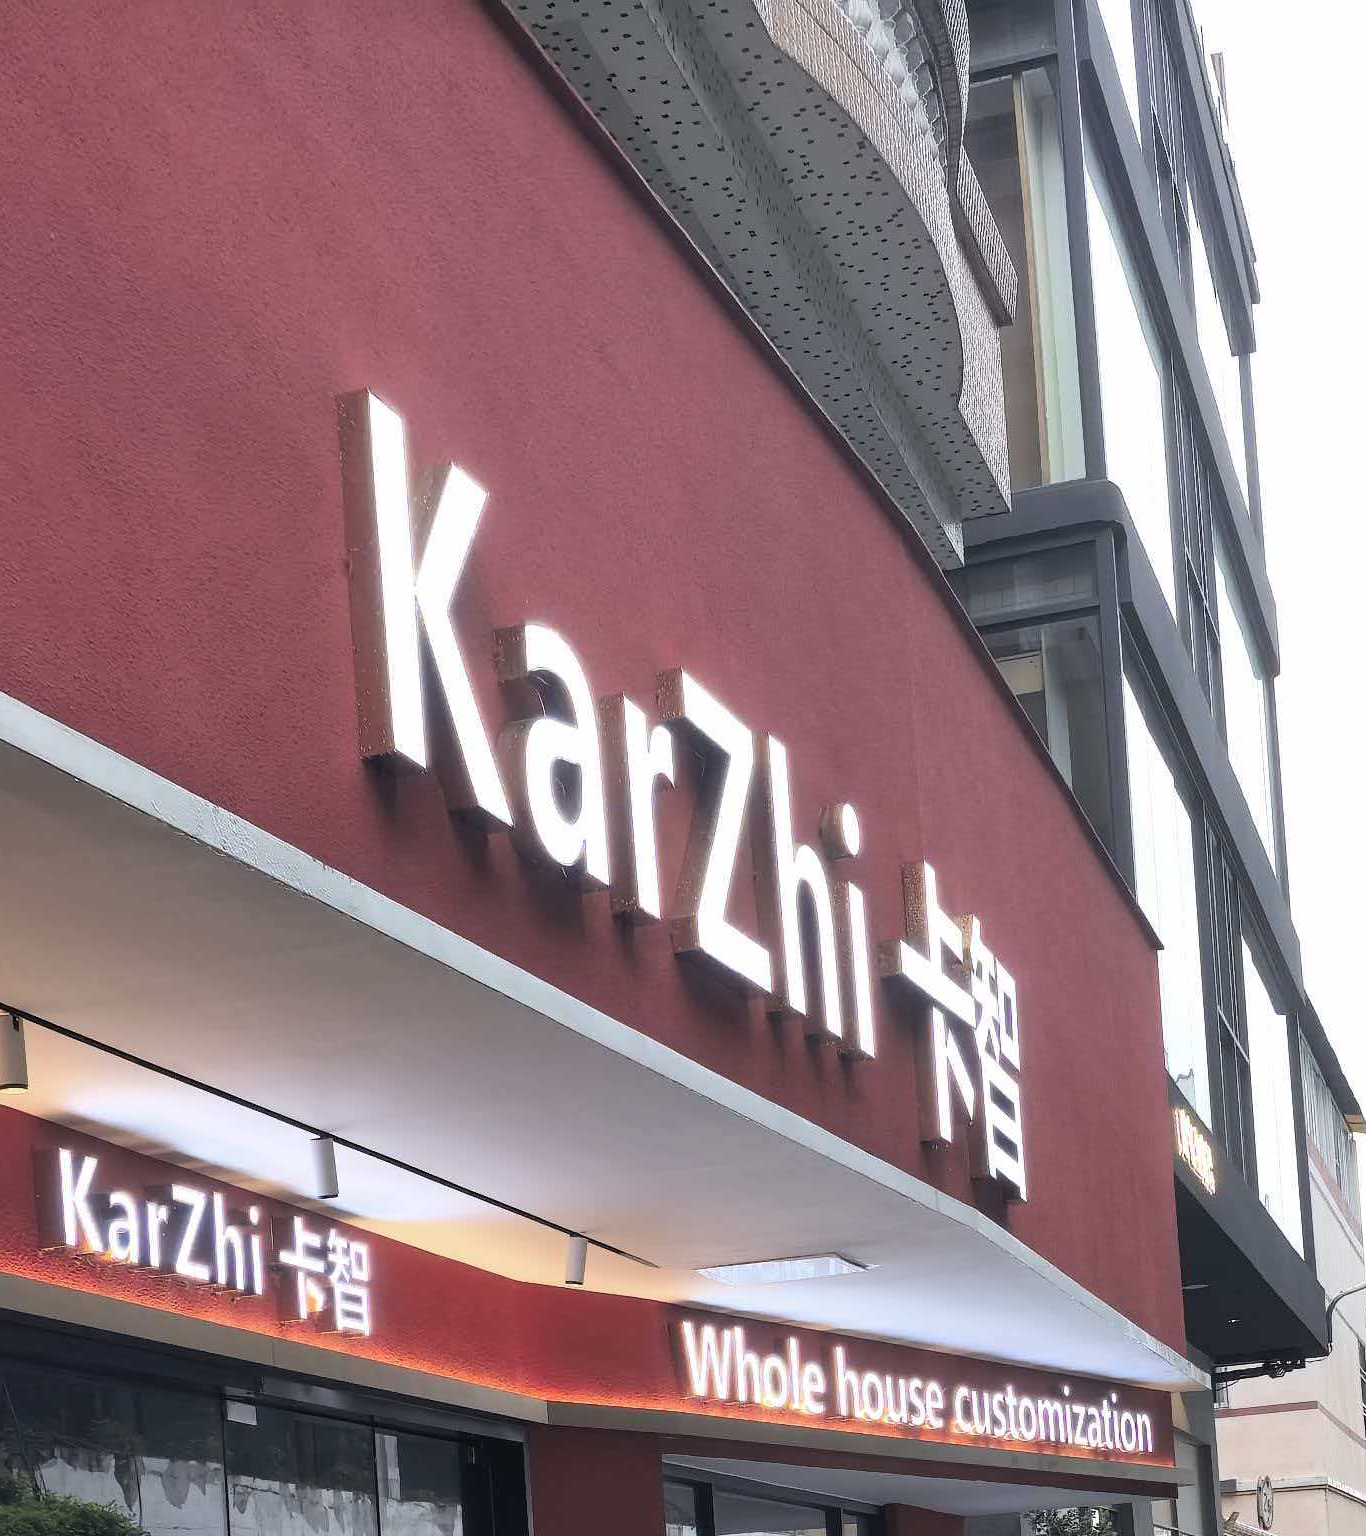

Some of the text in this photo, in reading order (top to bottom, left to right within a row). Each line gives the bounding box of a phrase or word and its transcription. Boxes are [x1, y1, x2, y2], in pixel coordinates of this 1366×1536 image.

[365, 387, 1029, 1203] KarZhi 卡智
[58, 1146, 372, 1338] KarZhi 卡智
[681, 1319, 1154, 1454] Whole house customization
